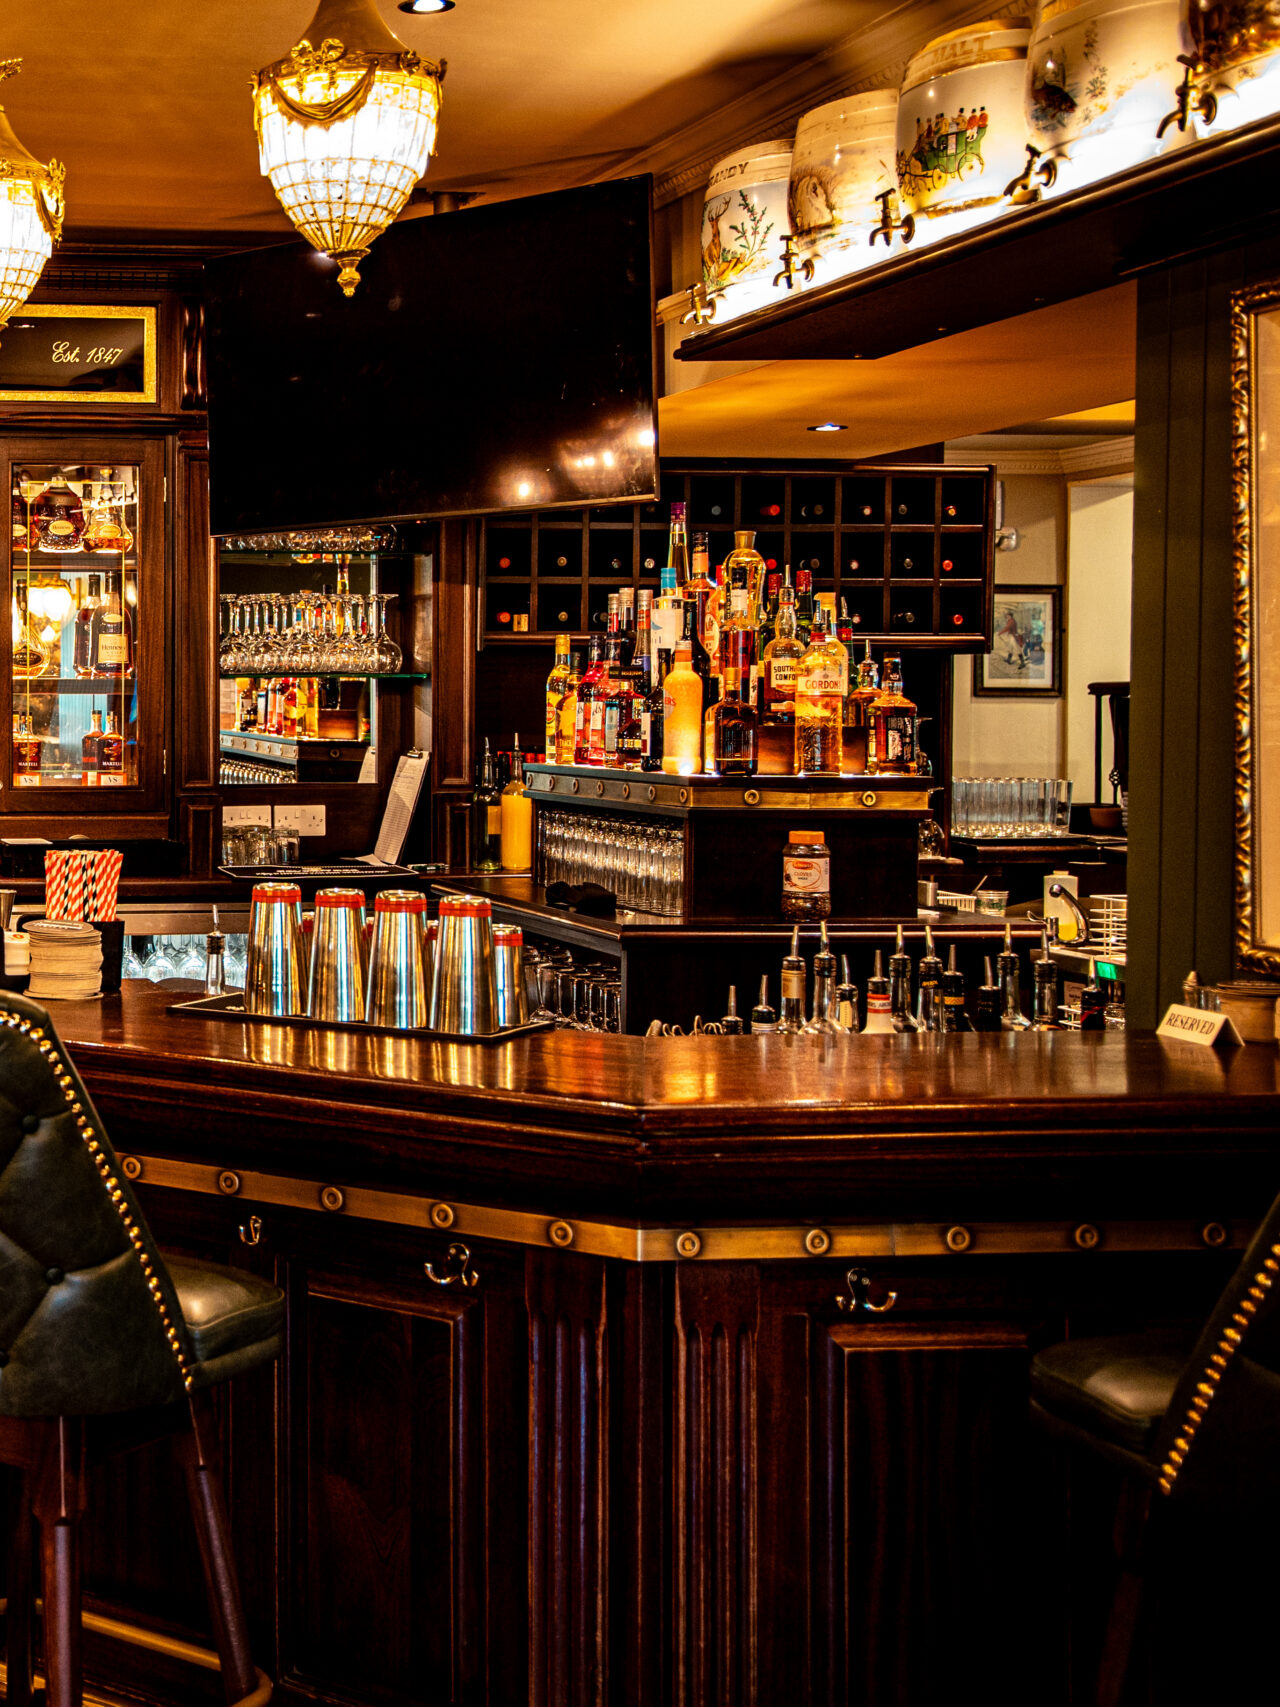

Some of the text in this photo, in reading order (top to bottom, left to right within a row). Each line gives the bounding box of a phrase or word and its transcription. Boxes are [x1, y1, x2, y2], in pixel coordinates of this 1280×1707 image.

[51, 340, 124, 365] Est. 1847
[775, 673, 796, 681] COMFO
[1166, 1012, 1216, 1036] RESERVED
